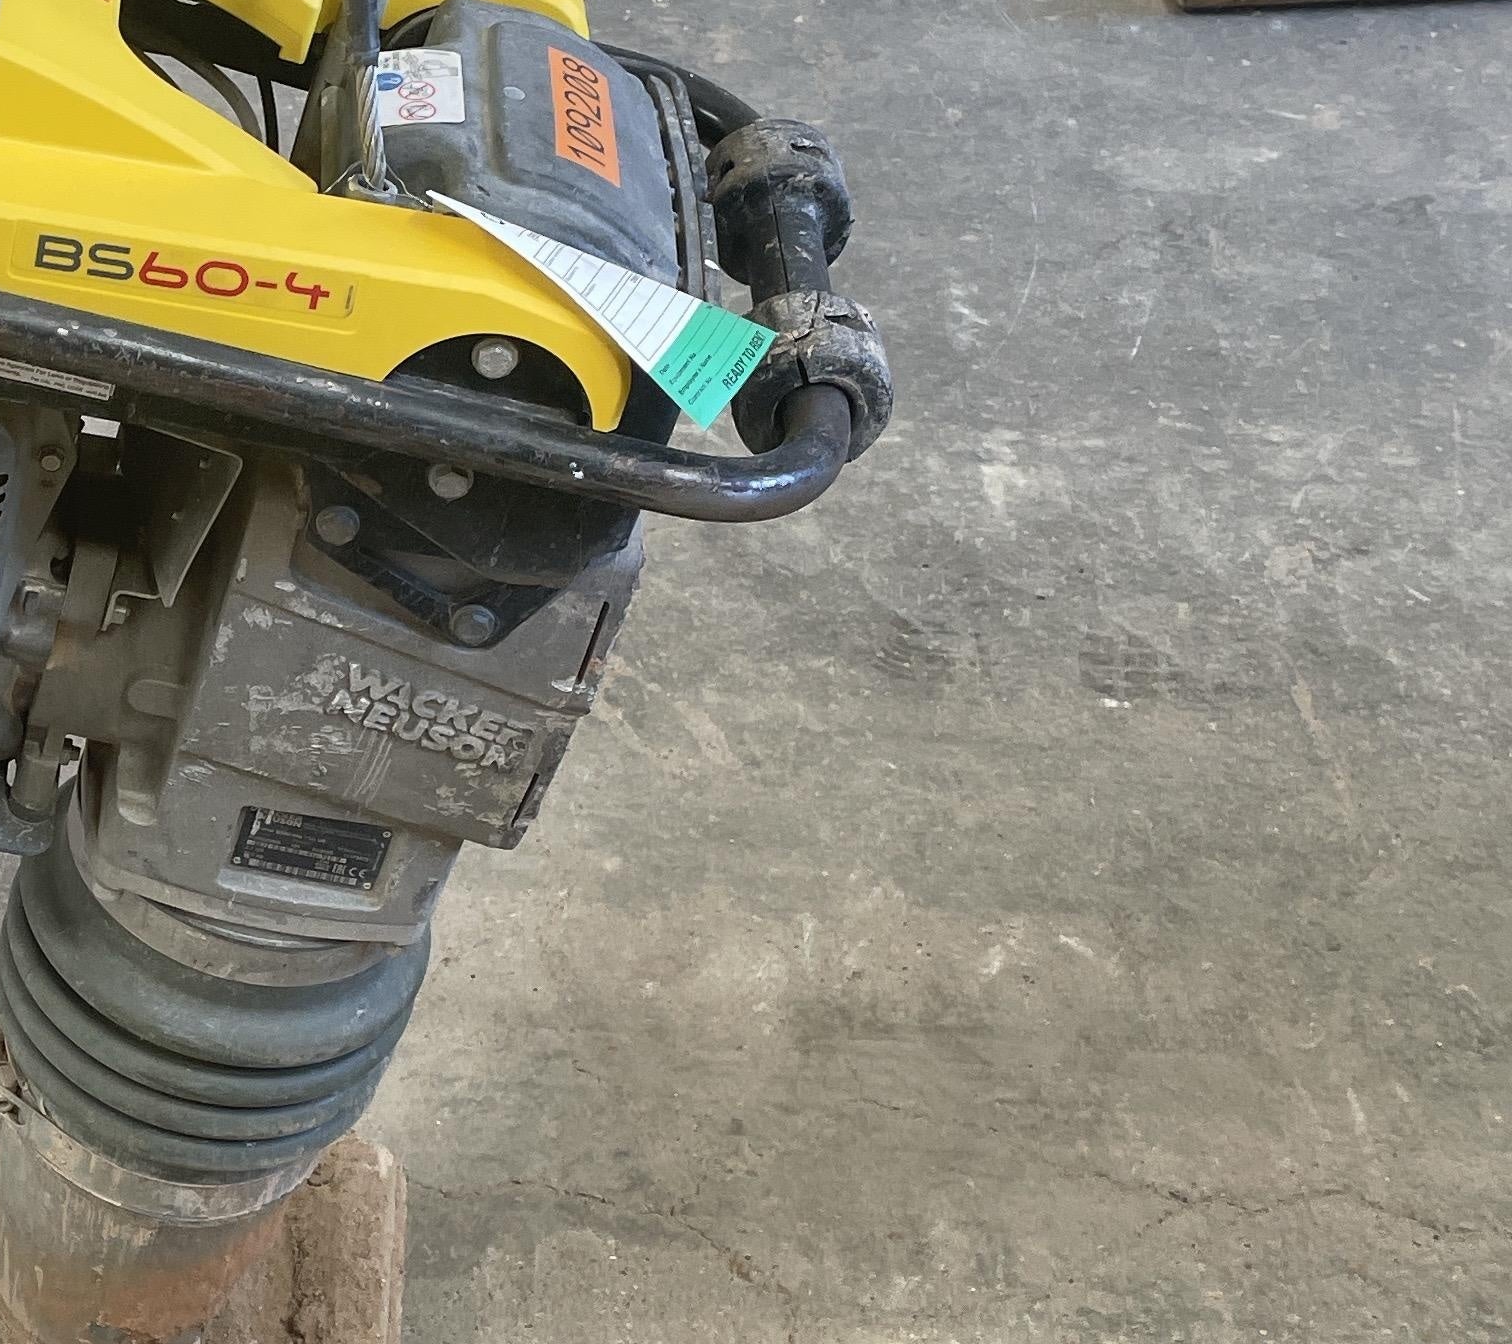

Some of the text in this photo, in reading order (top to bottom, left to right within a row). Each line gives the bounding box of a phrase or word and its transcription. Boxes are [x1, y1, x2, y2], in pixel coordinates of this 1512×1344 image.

[562, 57, 606, 167] 109208
[34, 234, 330, 311] BS60-4
[722, 356, 748, 390] READY
[741, 347, 756, 362] TO
[349, 662, 536, 746] WACKER
